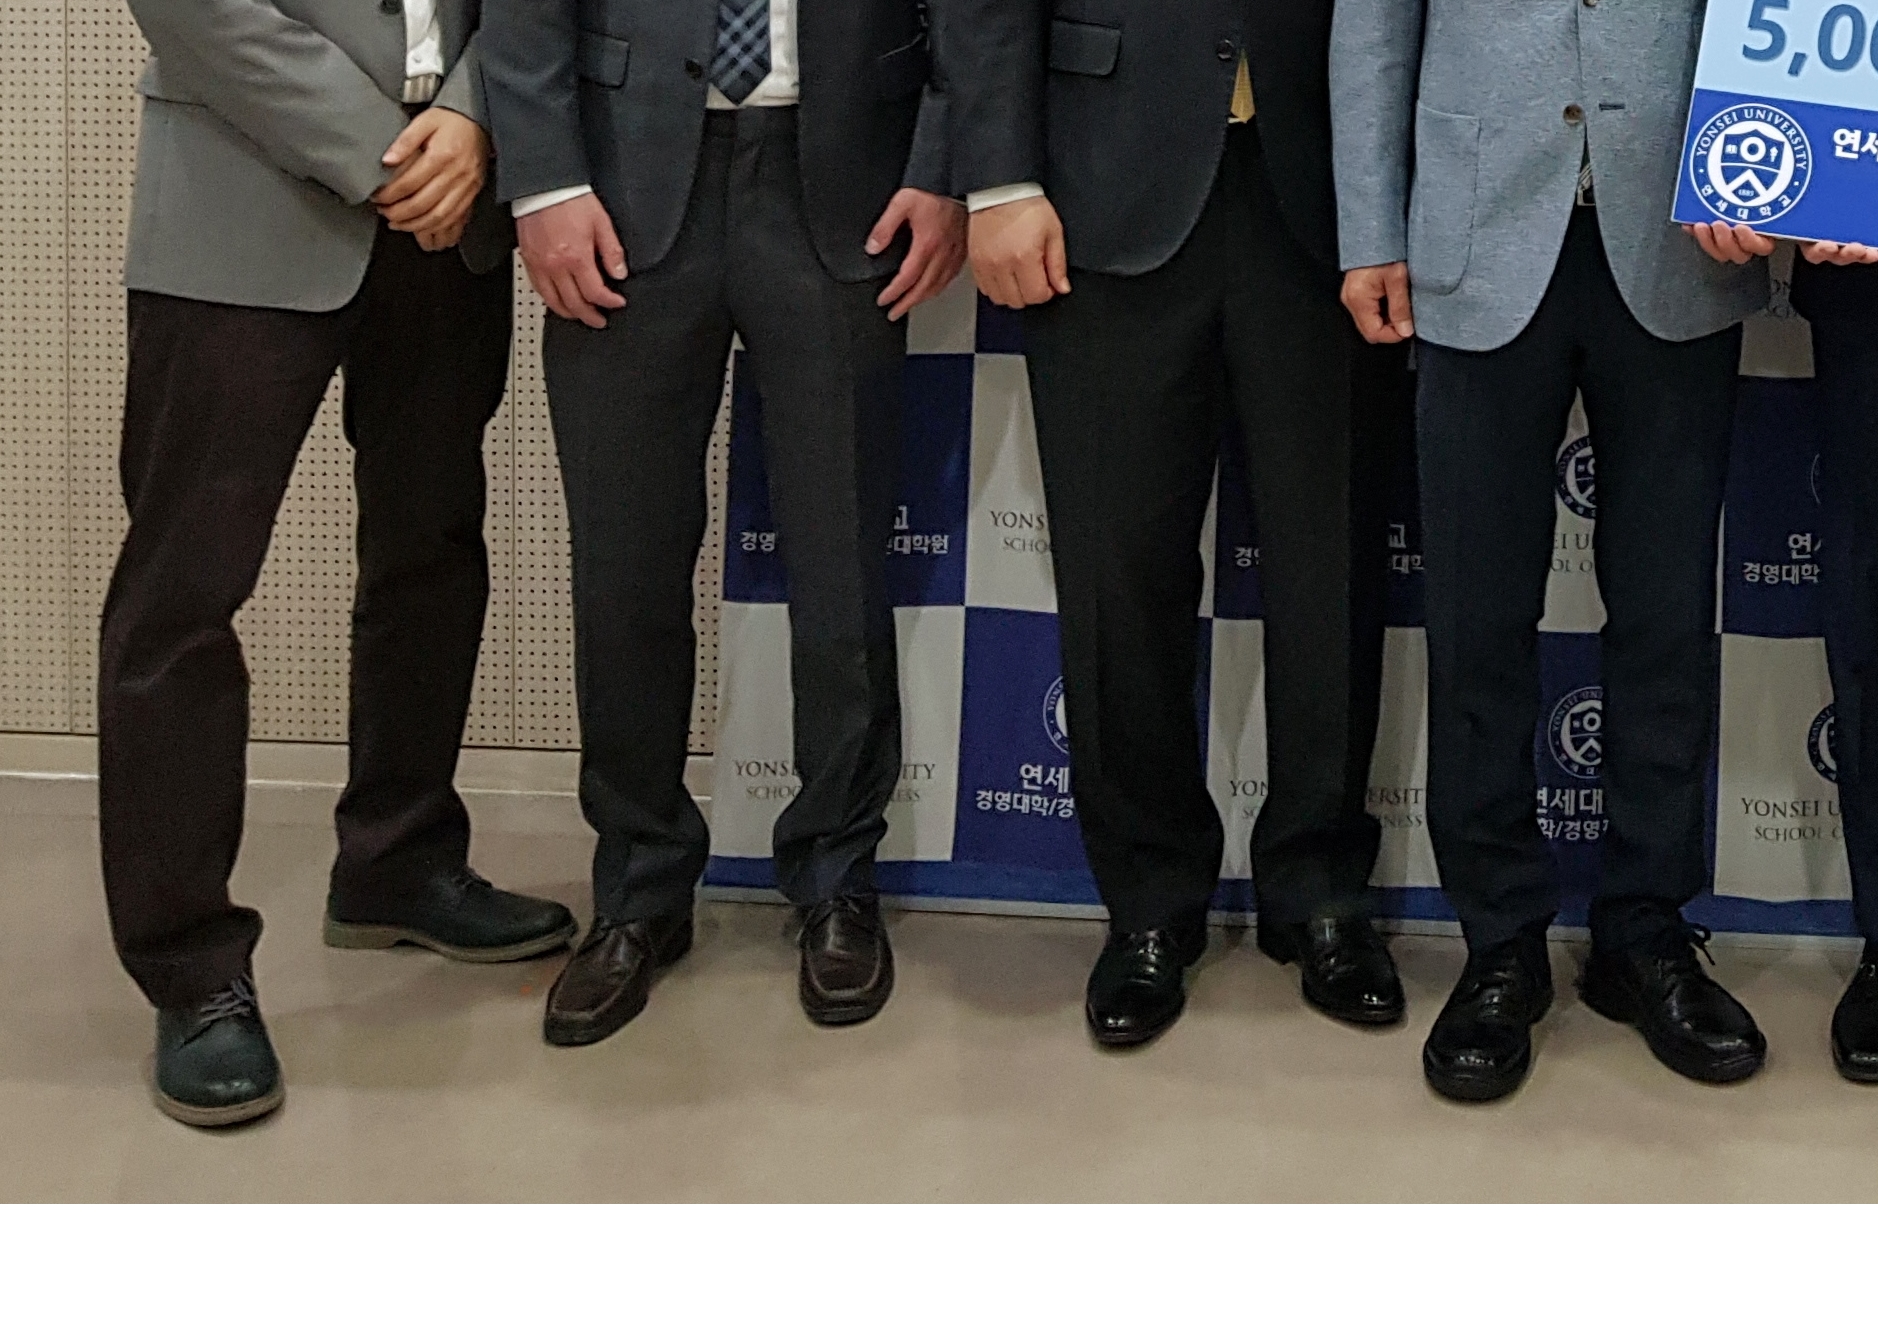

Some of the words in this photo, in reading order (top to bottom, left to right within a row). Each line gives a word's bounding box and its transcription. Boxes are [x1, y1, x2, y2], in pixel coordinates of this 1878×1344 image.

[1696, 111, 1738, 157] YONSEI
[1744, 108, 1807, 170] UNIVERSITY
[990, 510, 1045, 532] YONS
[734, 759, 800, 777] YONS
[1741, 798, 1819, 819] YONSEI
